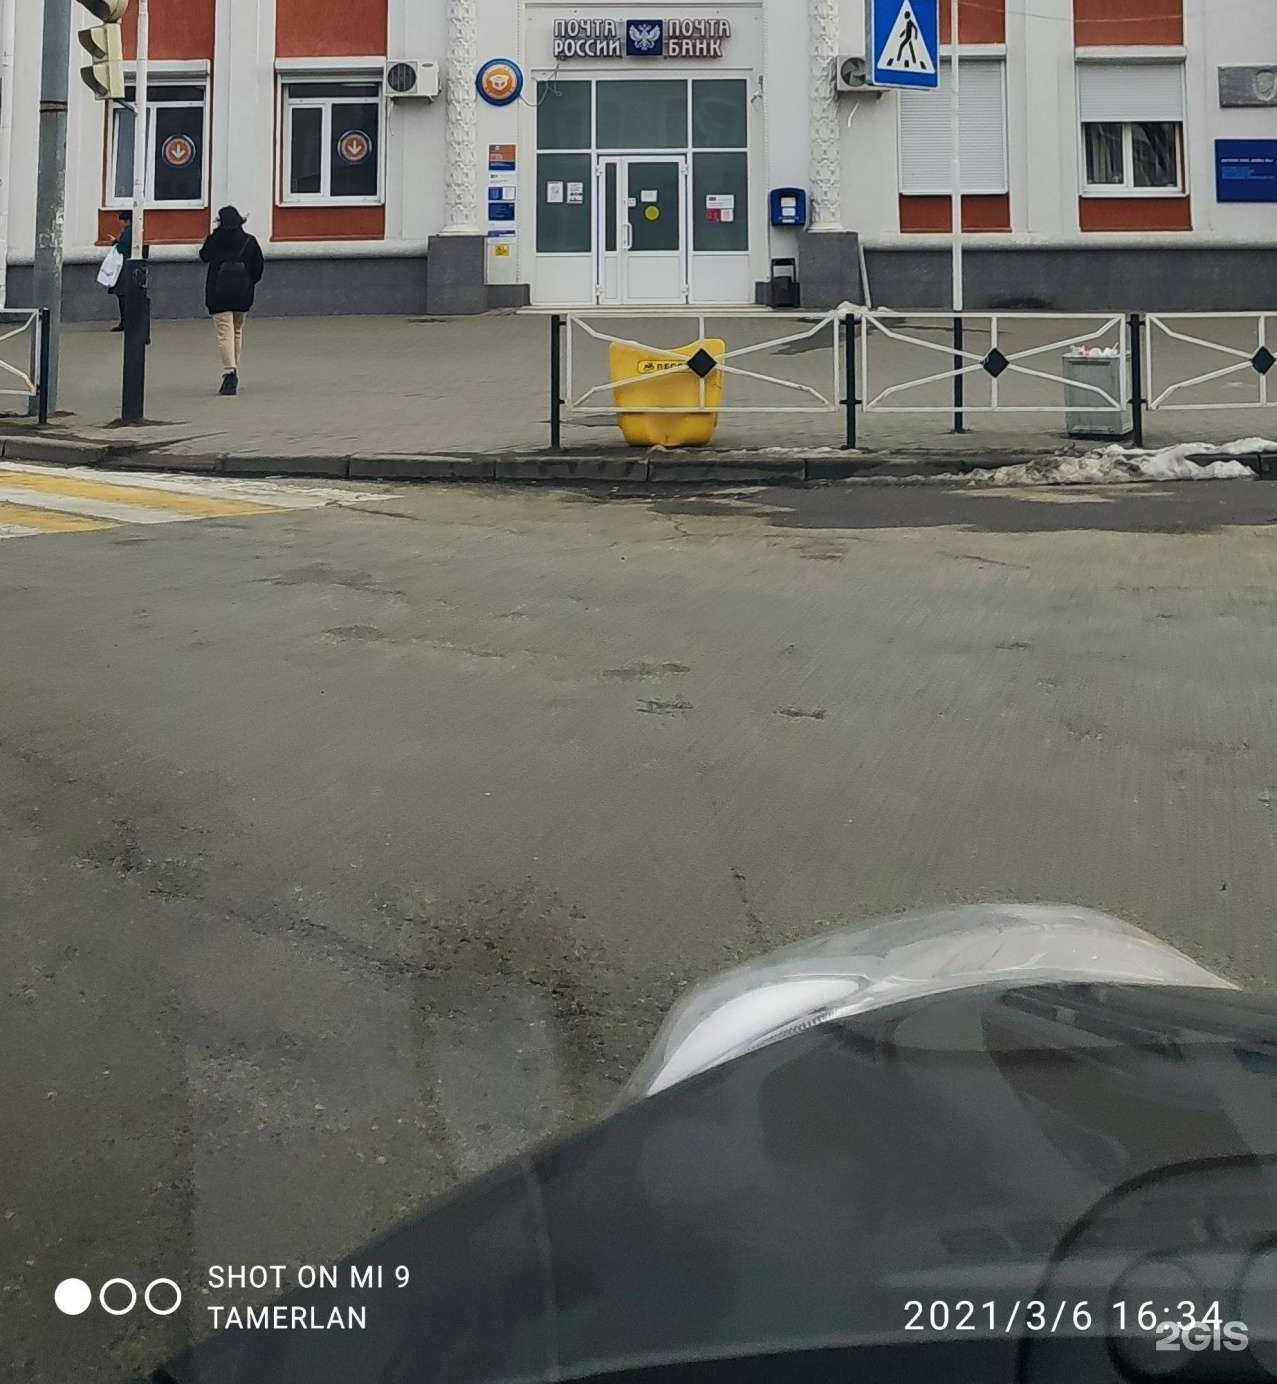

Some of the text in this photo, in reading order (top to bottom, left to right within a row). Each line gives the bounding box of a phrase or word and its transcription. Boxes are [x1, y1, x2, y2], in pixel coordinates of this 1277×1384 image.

[553, 18, 617, 37] ПОЧТА
[668, 18, 731, 37] ПОЧТА
[553, 38, 622, 57] РОССИИ
[668, 38, 723, 57] БАНК
